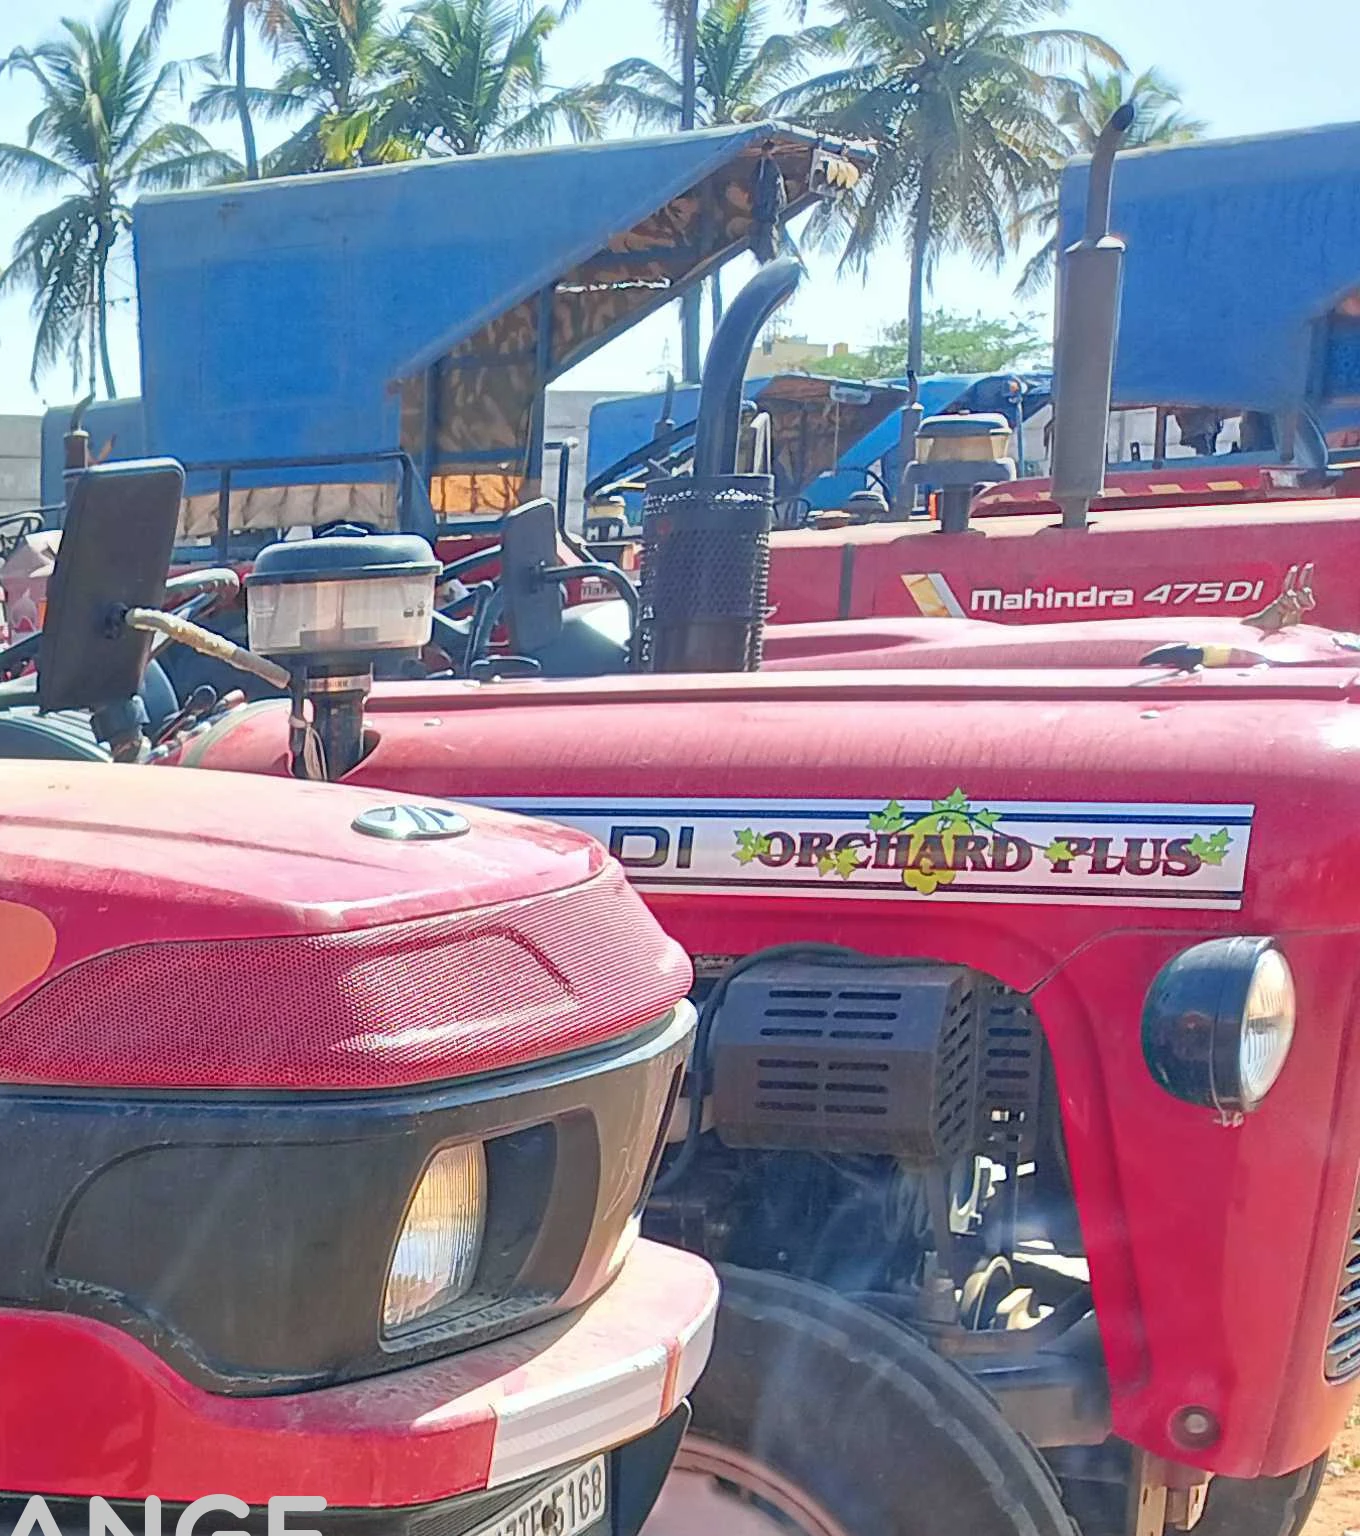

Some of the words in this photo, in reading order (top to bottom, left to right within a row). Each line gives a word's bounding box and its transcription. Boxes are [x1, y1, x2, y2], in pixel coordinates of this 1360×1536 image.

[971, 585, 1134, 611] Mahindra
[609, 824, 694, 870] DI
[757, 829, 1033, 875] ORCHARD
[1052, 835, 1199, 878] PLUS
